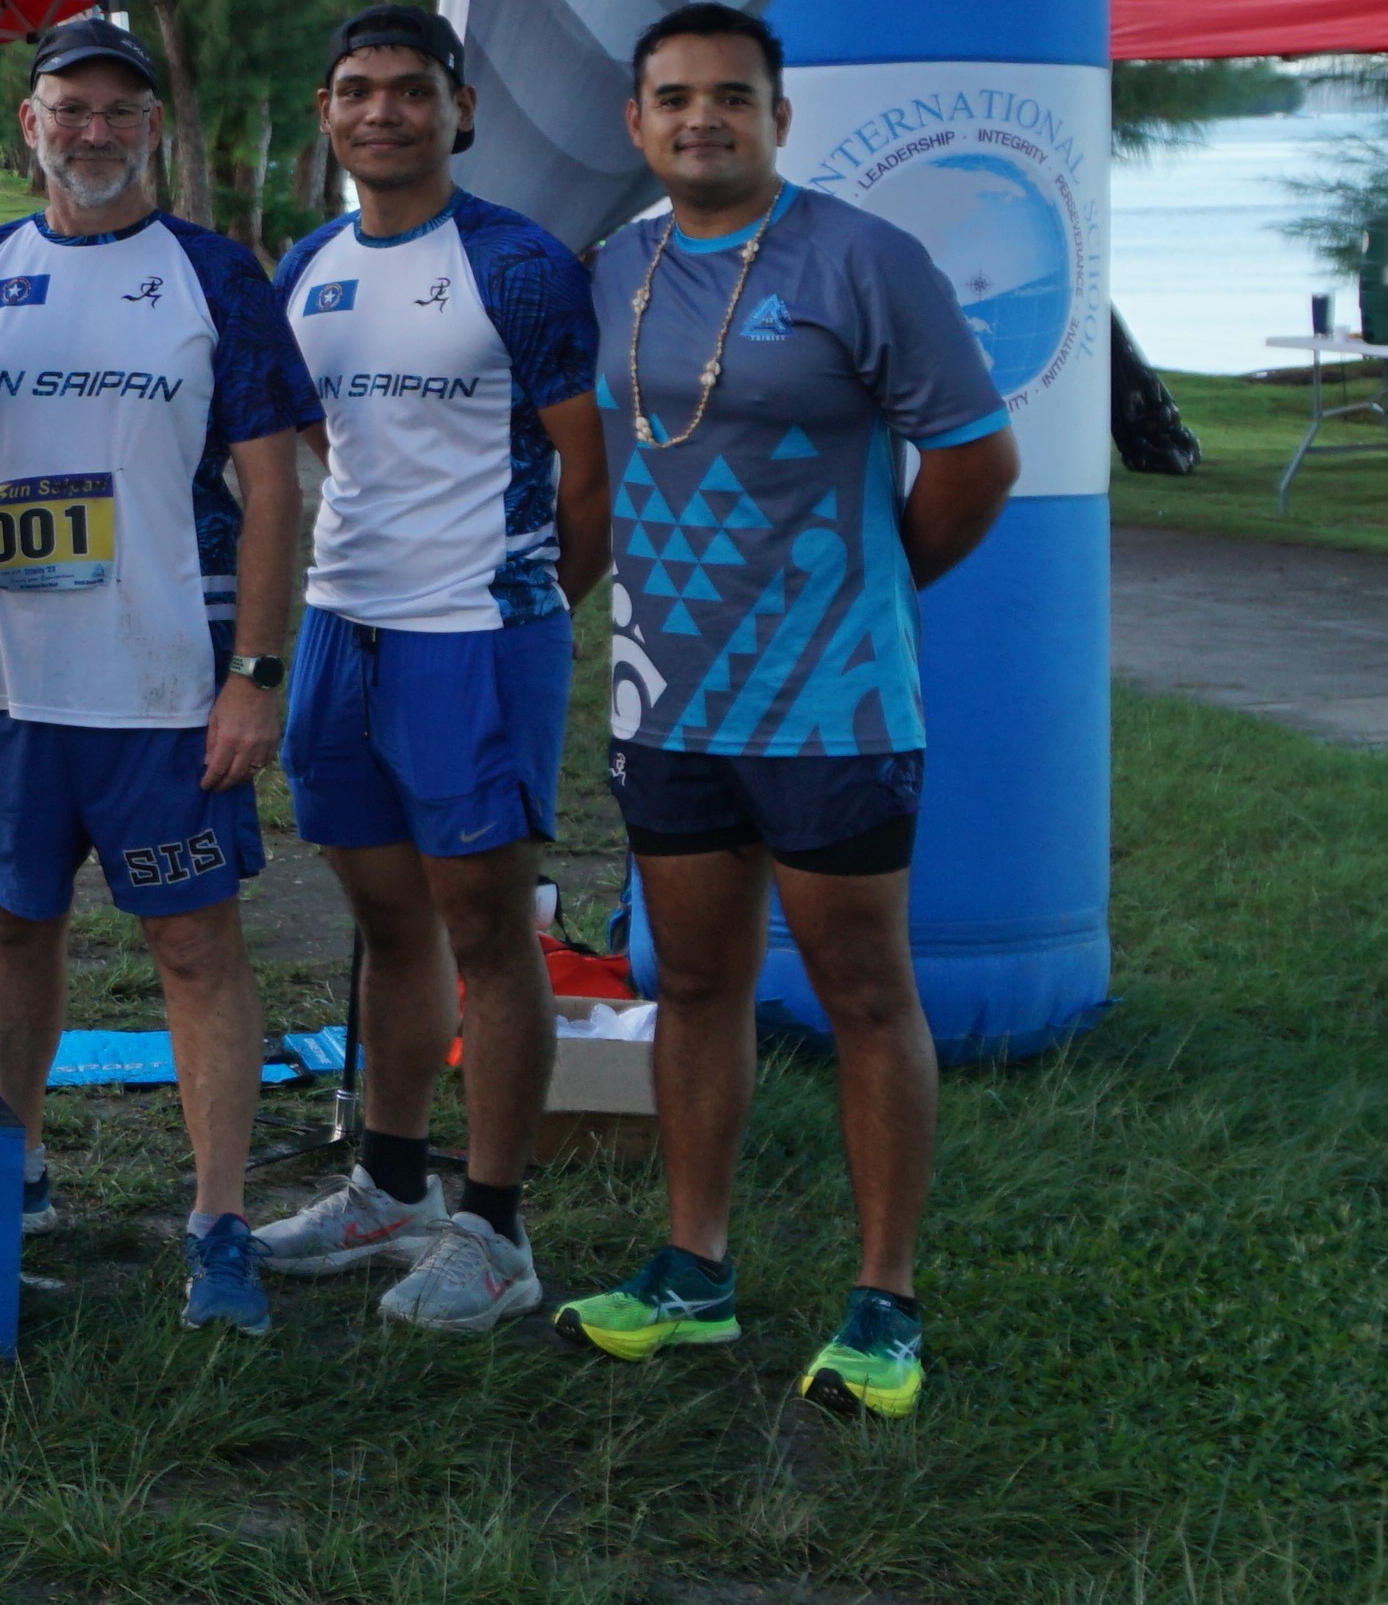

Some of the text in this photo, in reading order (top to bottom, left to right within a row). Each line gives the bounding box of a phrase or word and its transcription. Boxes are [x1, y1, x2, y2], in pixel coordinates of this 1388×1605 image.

[808, 89, 1085, 195] NTERNATIONAL
[857, 128, 1084, 298] LEADERSHIP INTEGRITY PERSEVERANCE
[1042, 315, 1079, 389] INITIATIVE
[32, 371, 183, 402] SAIPAN
[348, 374, 480, 400] SAIPAN
[123, 827, 226, 888] SIS
